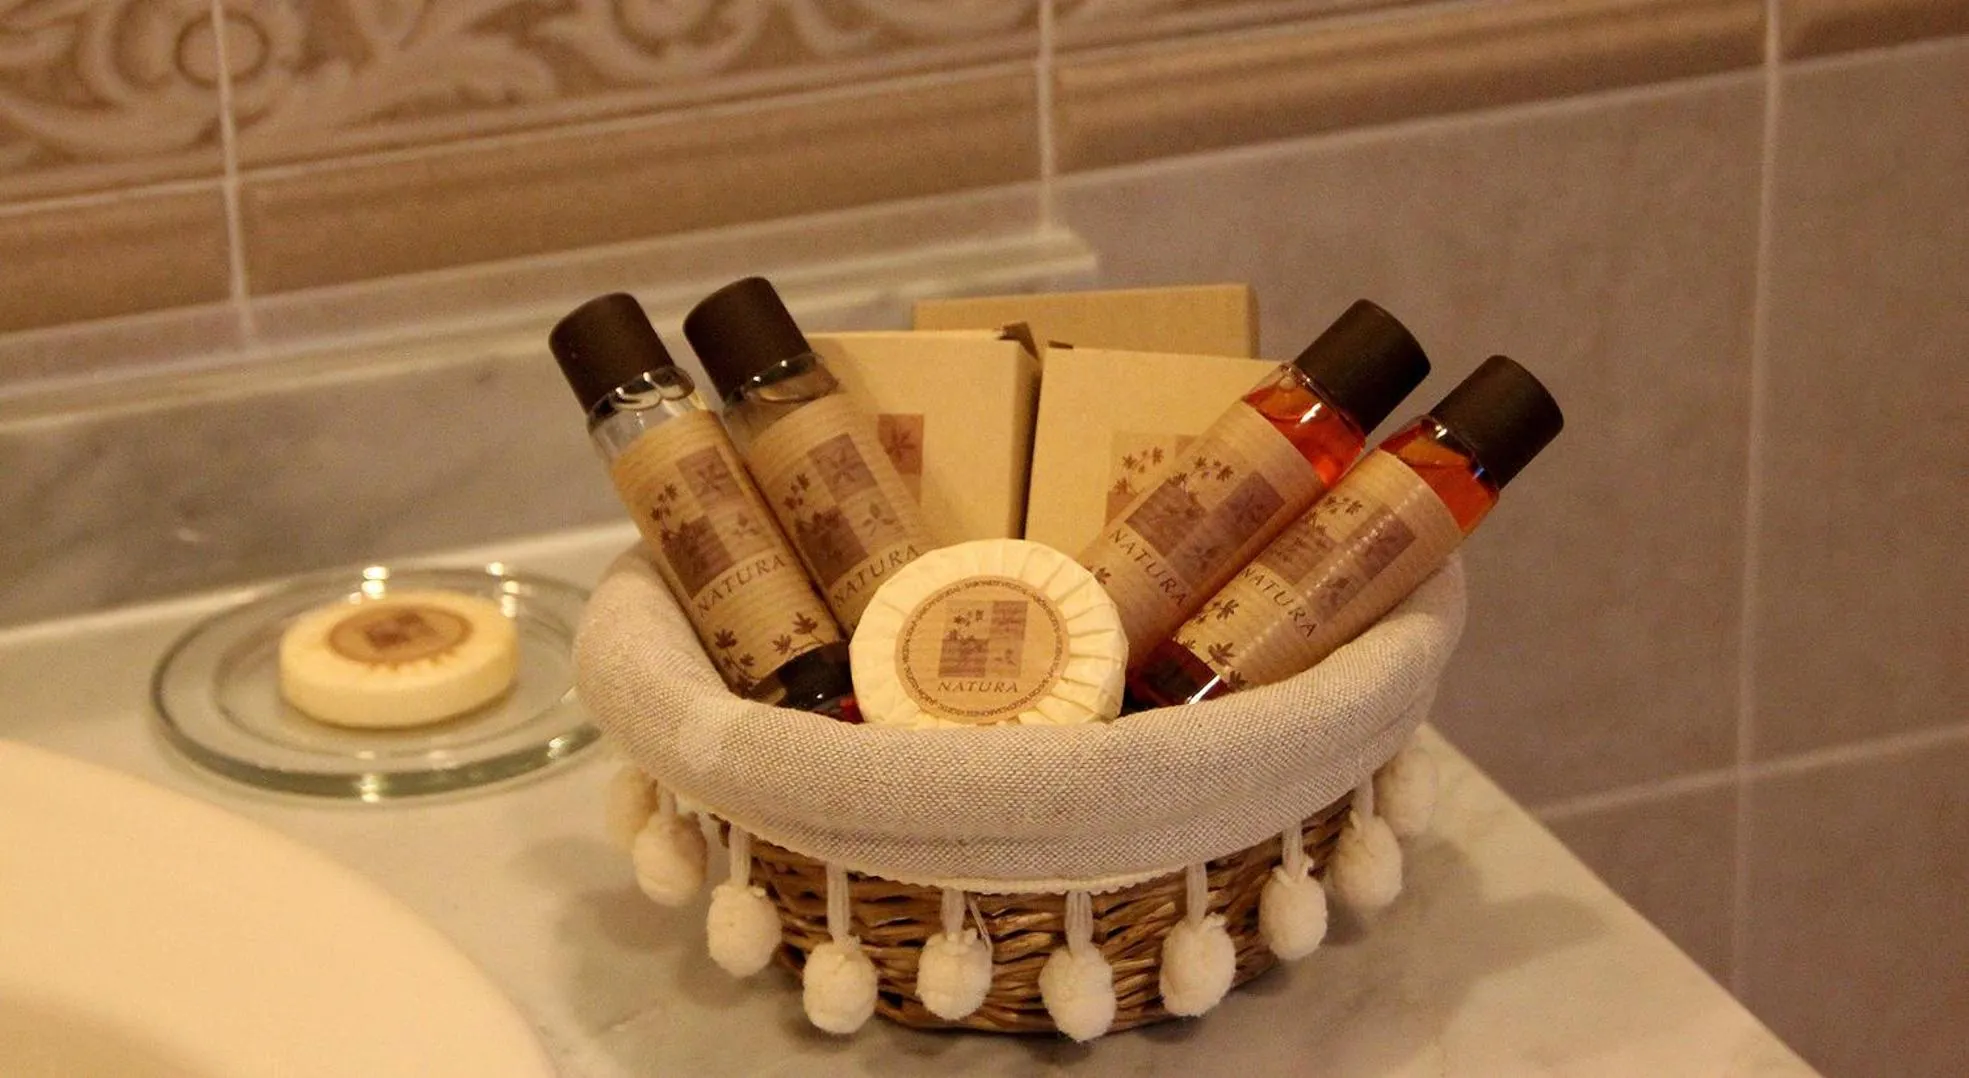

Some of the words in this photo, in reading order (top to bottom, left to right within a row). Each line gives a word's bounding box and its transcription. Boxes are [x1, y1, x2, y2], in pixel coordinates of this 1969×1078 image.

[698, 553, 786, 619] NATURA
[832, 543, 921, 609] NATURA
[1108, 527, 1187, 608] NATURA
[1241, 567, 1318, 638] NATURA
[937, 681, 1019, 693] NATURA
